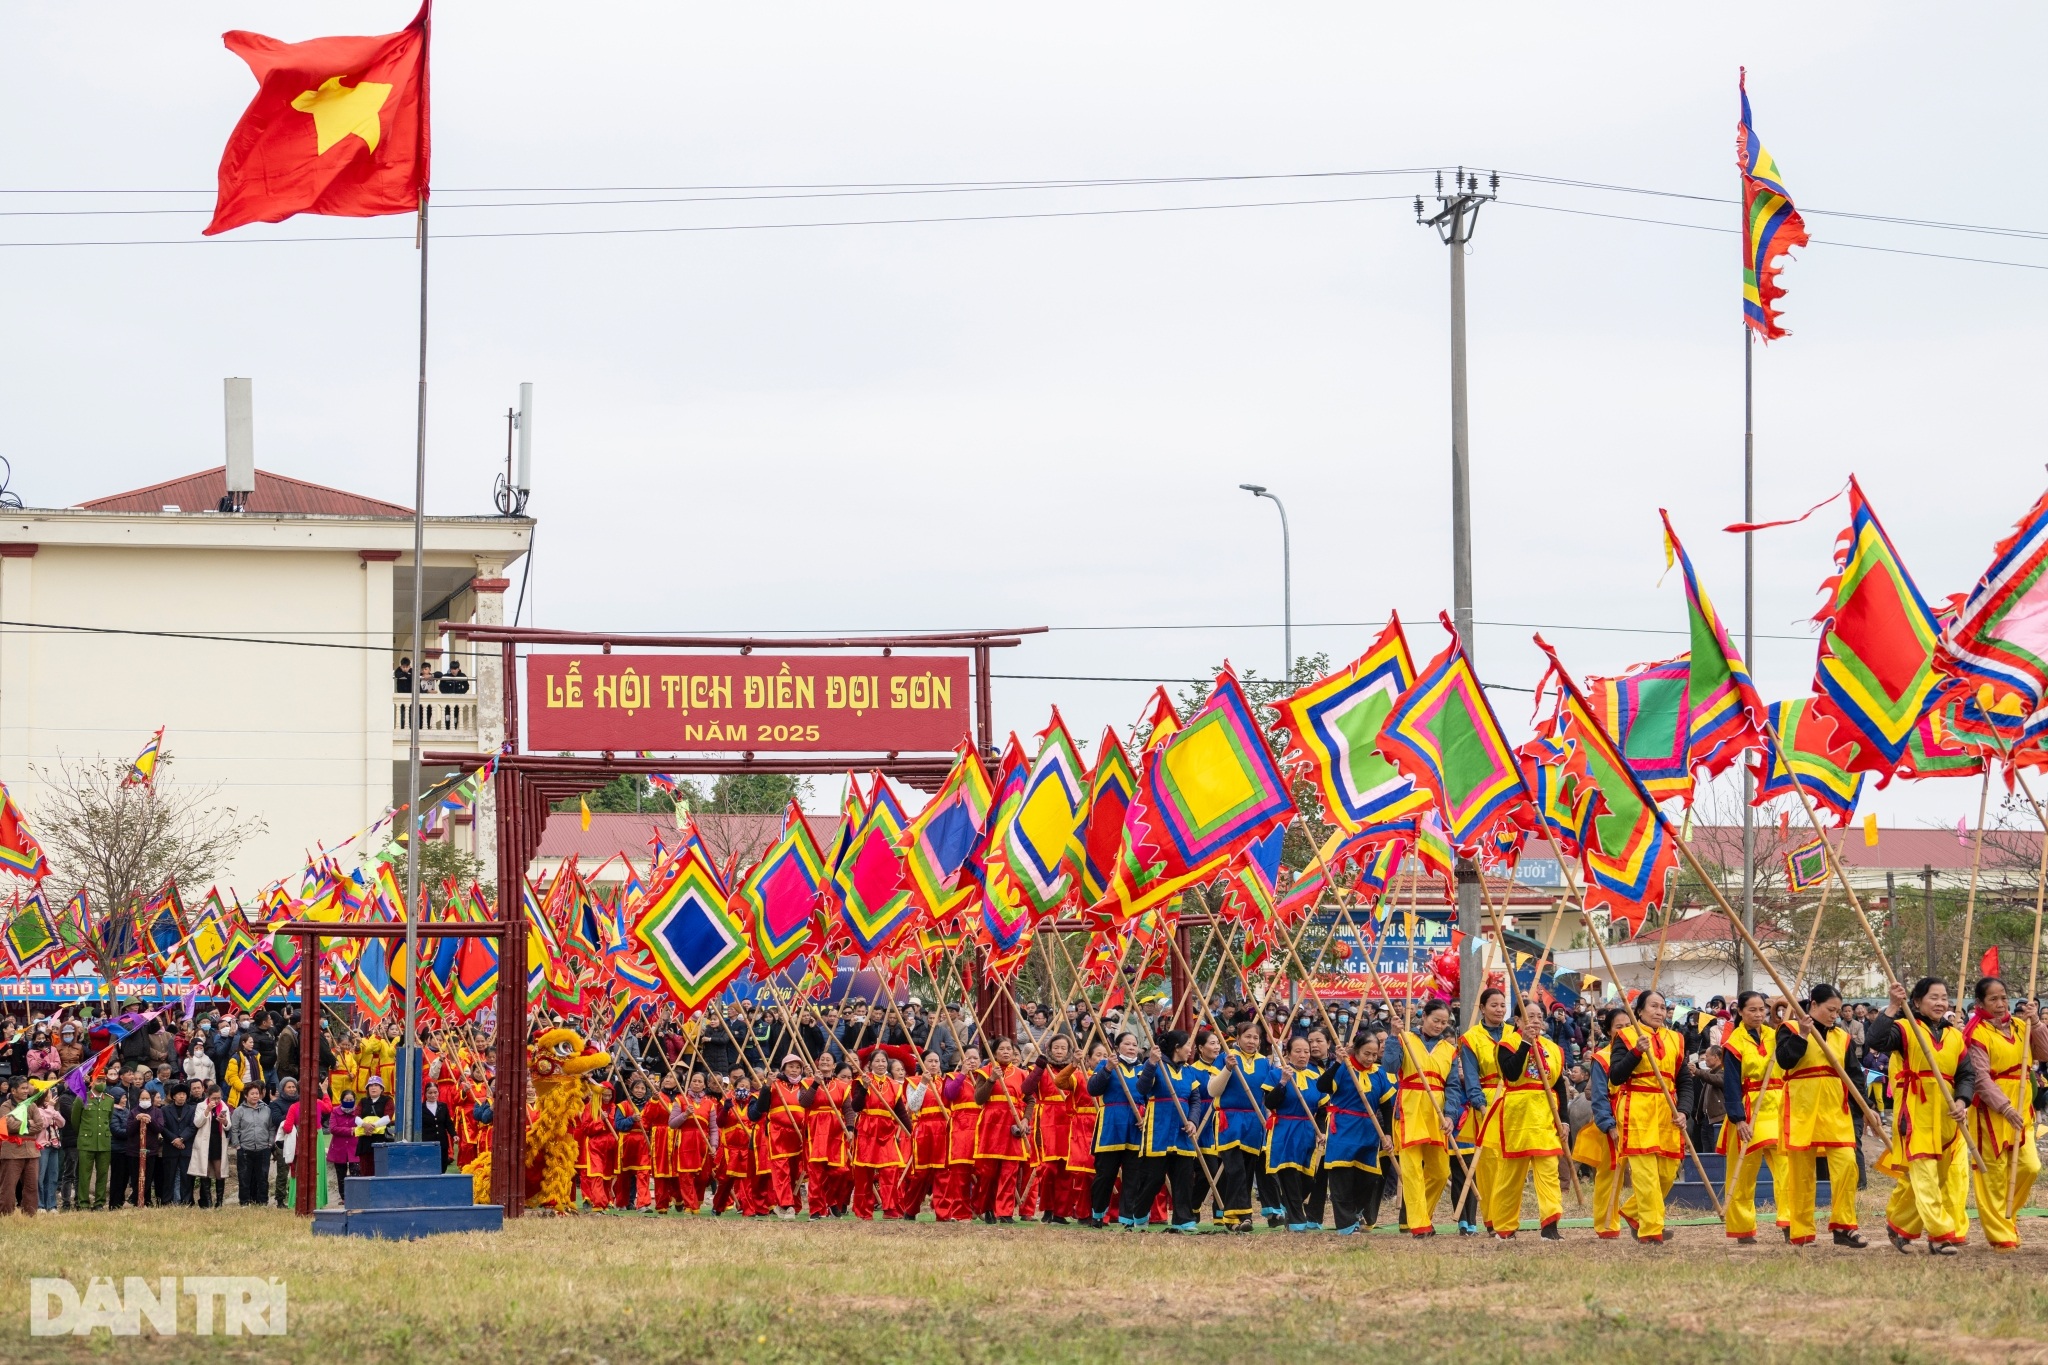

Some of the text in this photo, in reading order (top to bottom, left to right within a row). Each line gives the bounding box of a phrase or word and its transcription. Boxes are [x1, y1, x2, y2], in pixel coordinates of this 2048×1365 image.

[547, 661, 952, 716] LỄ HỘI TỊCH ĐIỀN ĐỌI SƠN
[684, 721, 820, 742] NĂM 2025
